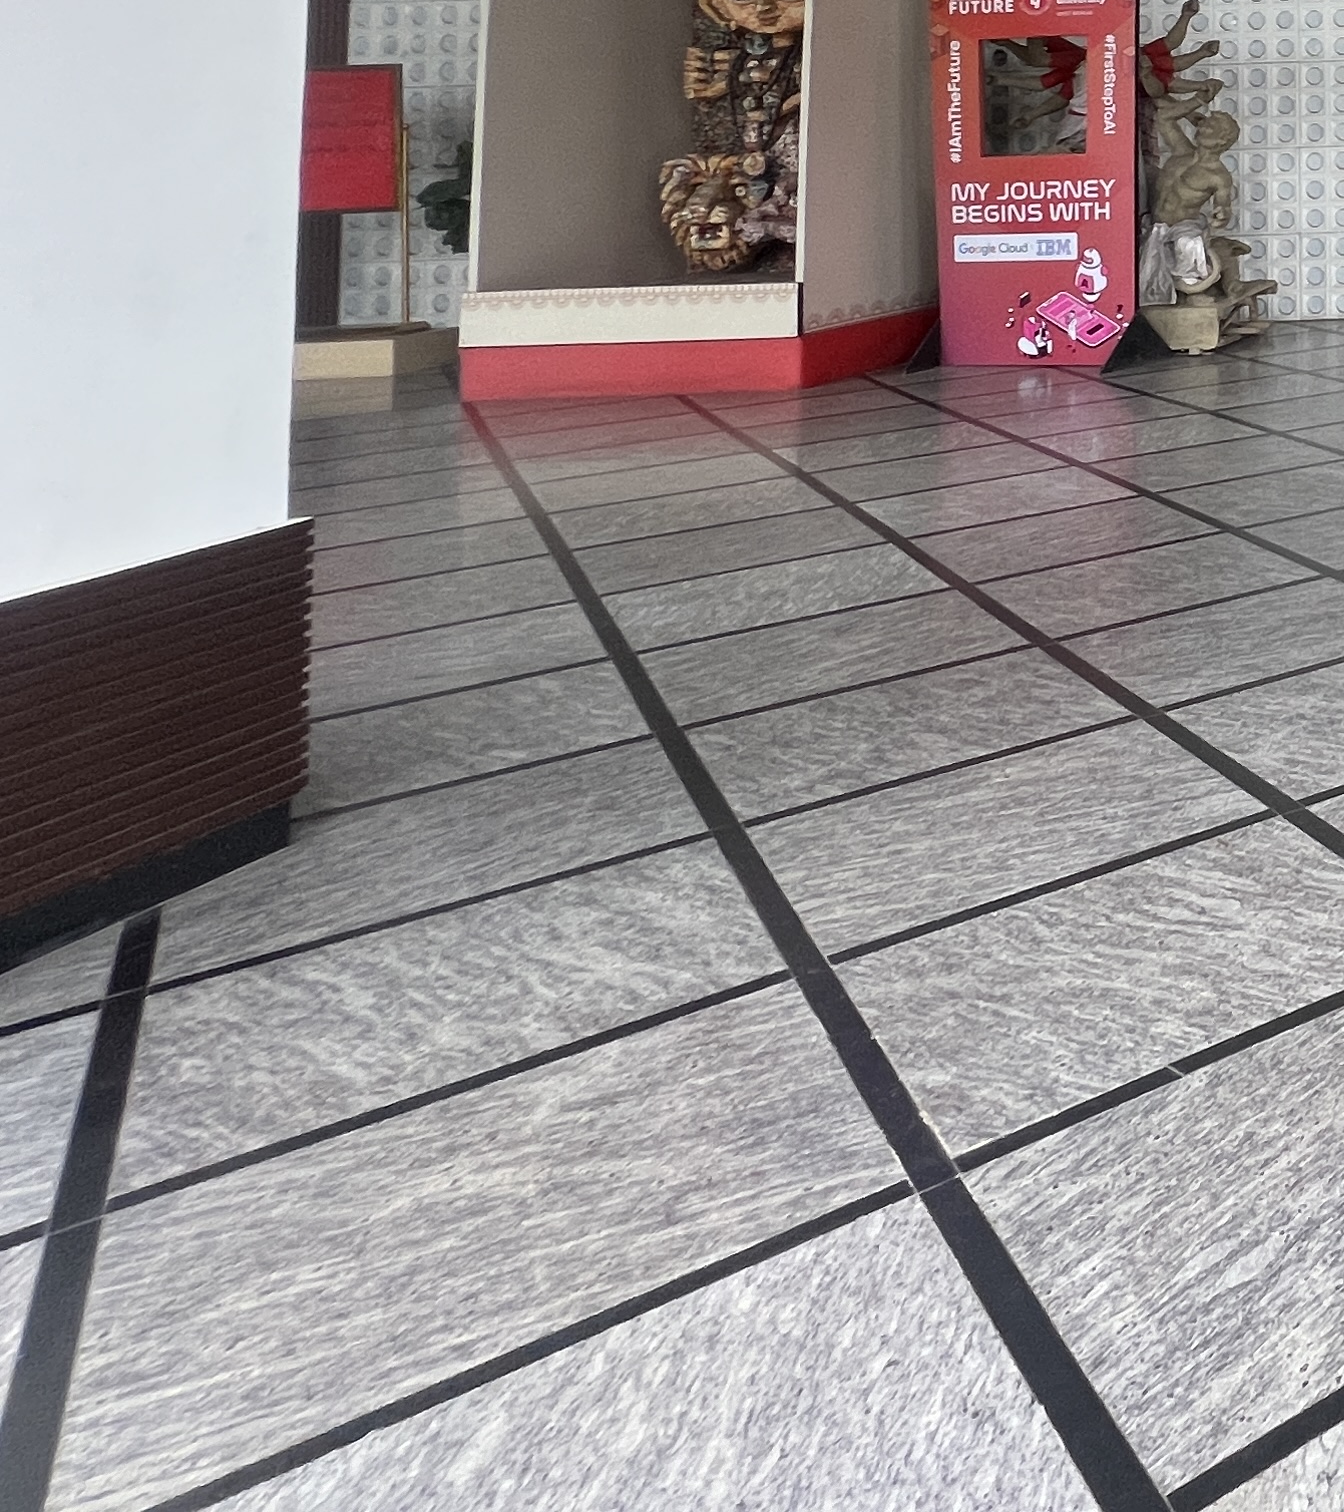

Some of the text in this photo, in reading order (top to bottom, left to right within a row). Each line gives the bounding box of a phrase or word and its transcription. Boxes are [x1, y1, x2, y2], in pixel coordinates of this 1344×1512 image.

[948, 0, 1015, 15] FUTURE
[947, 40, 962, 164] #IAmTheFuture
[951, 179, 1116, 202] MY JOURNEY
[952, 201, 1111, 224] BEGINS WITH
[958, 239, 1072, 257] Google Cloud IBM
